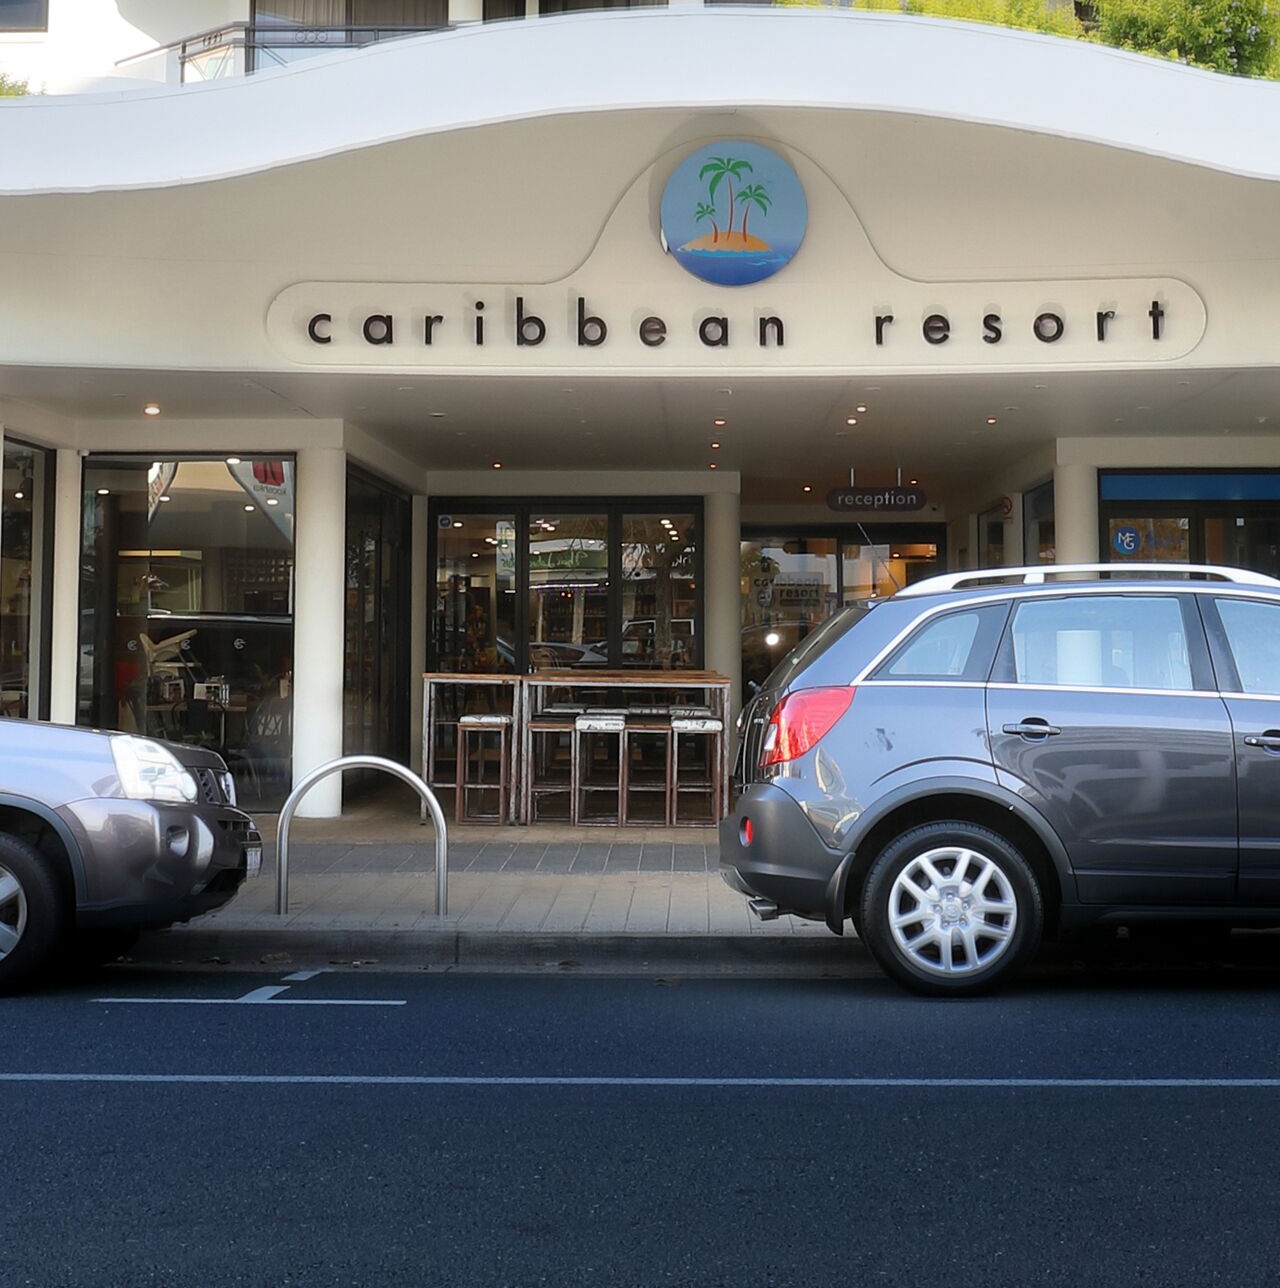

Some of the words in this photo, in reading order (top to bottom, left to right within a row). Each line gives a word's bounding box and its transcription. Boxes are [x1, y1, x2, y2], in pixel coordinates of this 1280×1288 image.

[307, 297, 786, 348] caribbean
[874, 300, 1166, 345] resort
[838, 491, 917, 508] reception
[780, 588, 819, 598] resort
